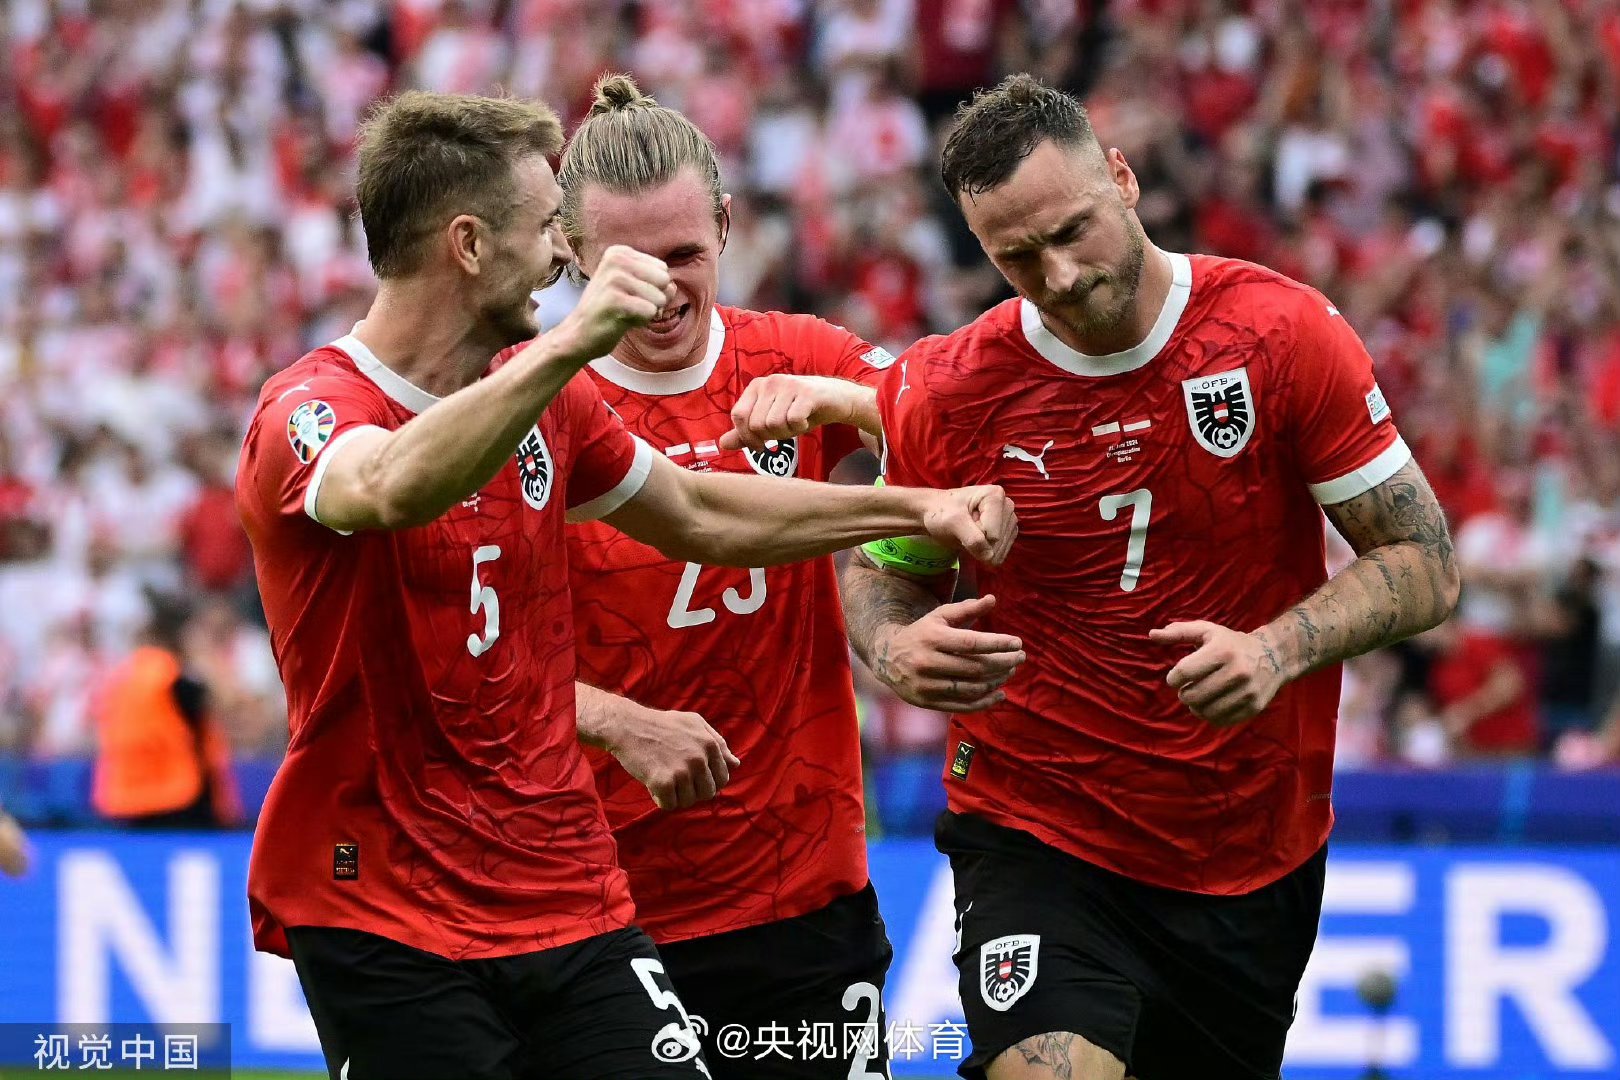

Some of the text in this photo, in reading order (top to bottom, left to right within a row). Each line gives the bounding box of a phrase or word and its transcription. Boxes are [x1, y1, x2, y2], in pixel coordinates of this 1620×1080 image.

[1098, 487, 1153, 592] 7
[466, 544, 502, 658] 5
[841, 981, 894, 1080] 2
